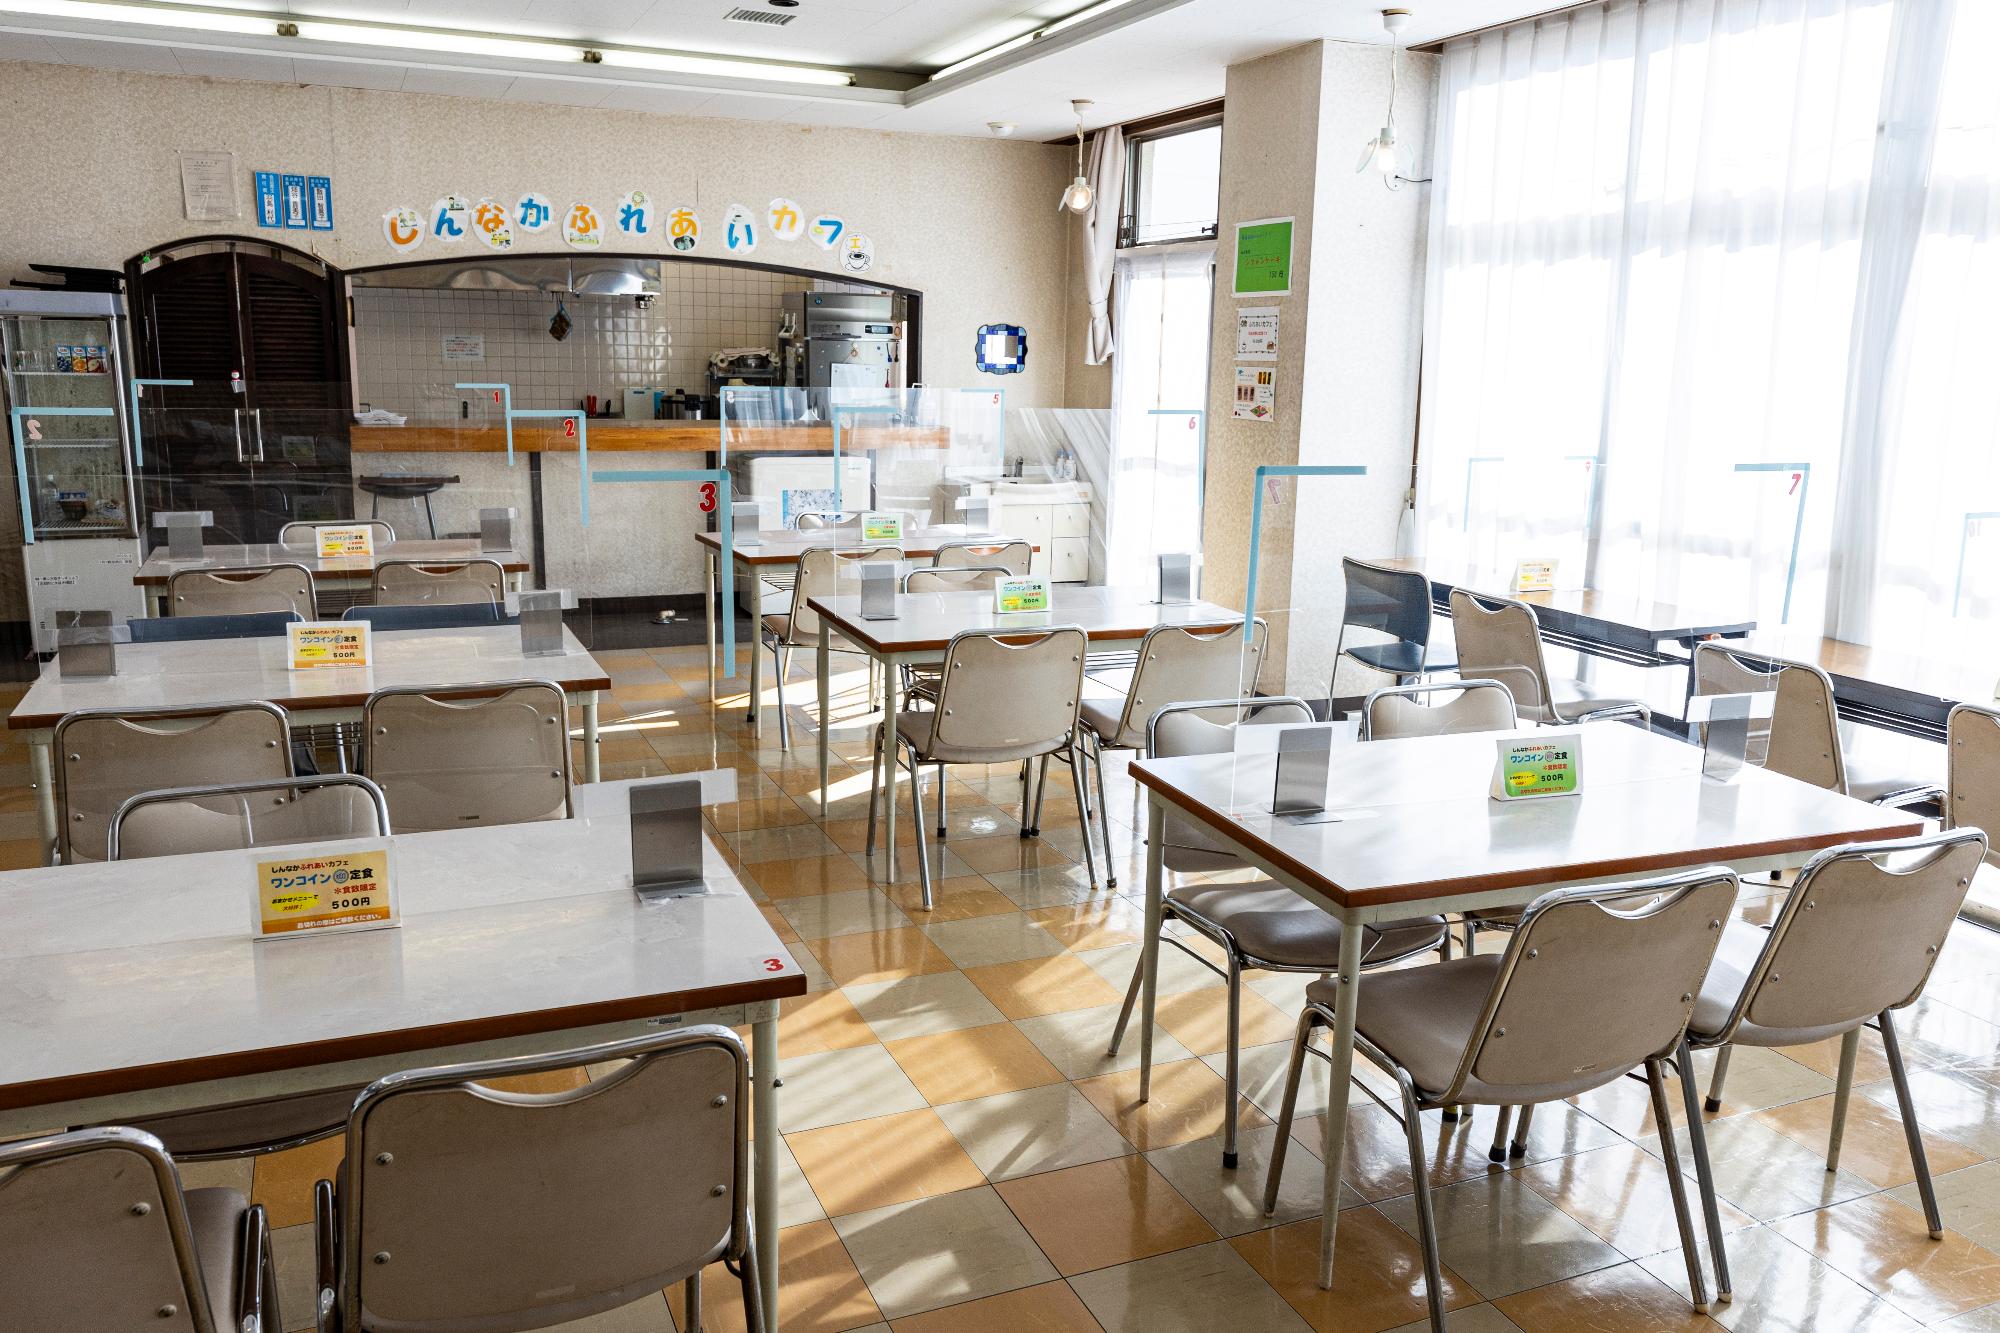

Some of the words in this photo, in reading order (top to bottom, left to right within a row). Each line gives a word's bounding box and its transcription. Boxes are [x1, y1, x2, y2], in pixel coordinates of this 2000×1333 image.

[494, 390, 500, 404] 1
[992, 393, 1000, 405] 5
[563, 418, 575, 438] 2
[1188, 416, 1197, 430] 6
[1788, 473, 1802, 496] 7
[699, 482, 717, 513] 3
[272, 861, 349, 873] しんなかふれあいカフェ
[271, 874, 331, 888] ワンコイン
[350, 868, 373, 880] 定食
[331, 896, 370, 910] 500円
[762, 958, 785, 972] 3
